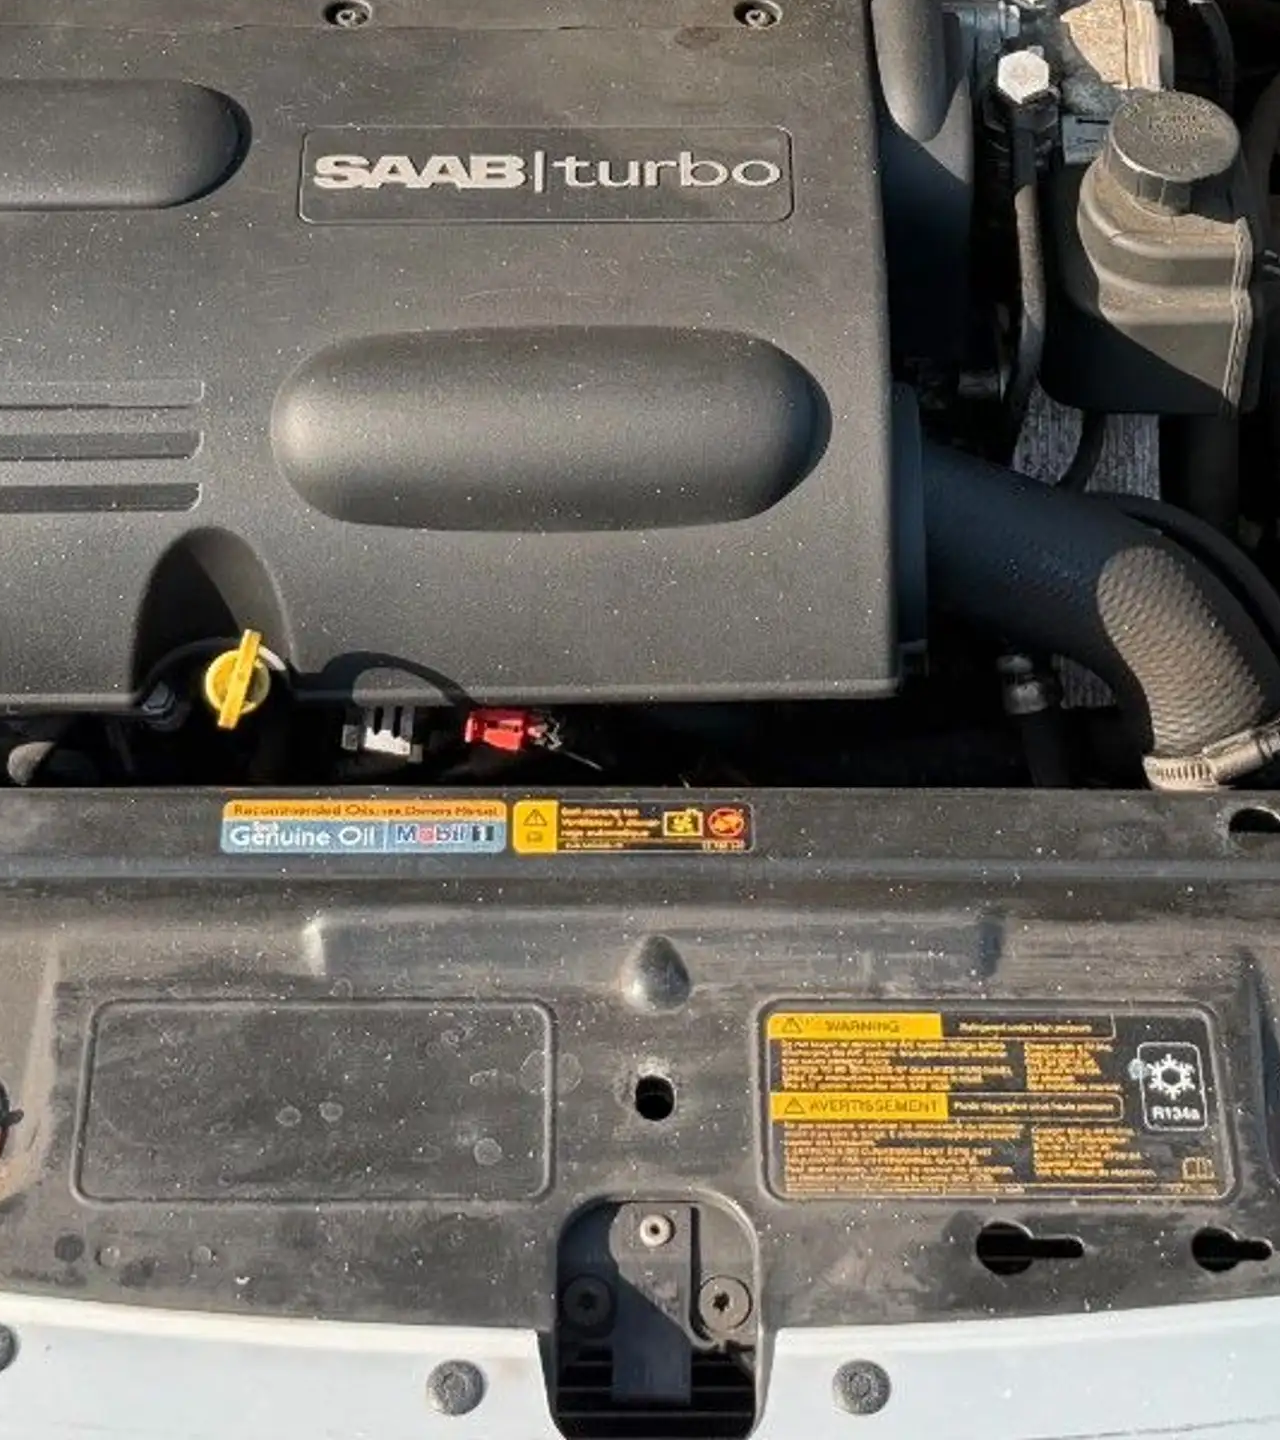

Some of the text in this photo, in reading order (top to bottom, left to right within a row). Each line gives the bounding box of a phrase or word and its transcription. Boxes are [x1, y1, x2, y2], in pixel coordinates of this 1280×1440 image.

[313, 152, 782, 189] SAAB turbo
[230, 825, 376, 847] Genuine Oil
[396, 824, 465, 843] Mobil
[824, 1020, 901, 1034] WARNING
[810, 1100, 938, 1115] AVERTISSEMENT
[1152, 1105, 1201, 1121] R134a
